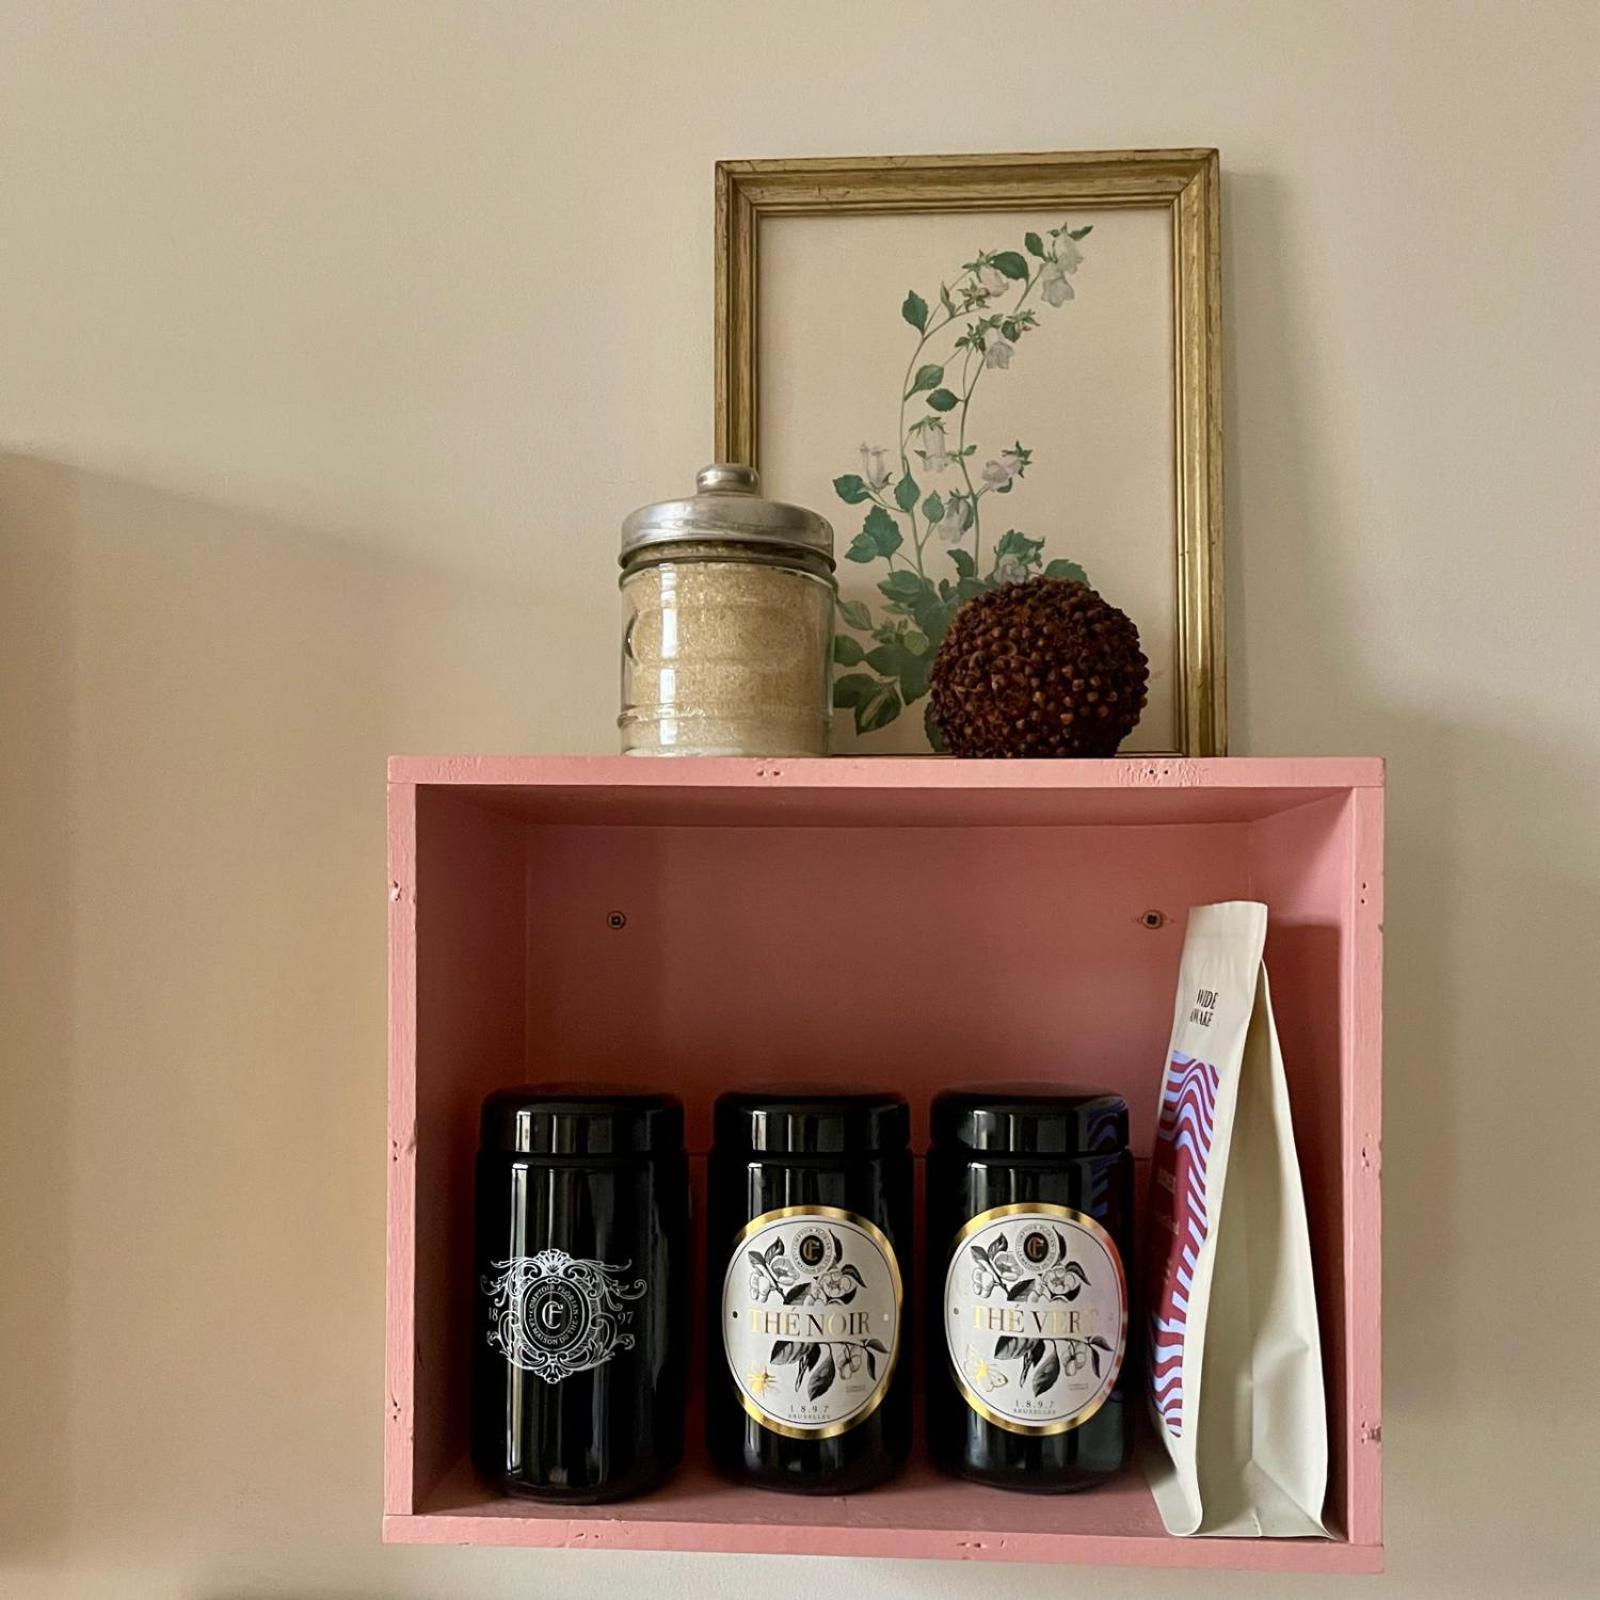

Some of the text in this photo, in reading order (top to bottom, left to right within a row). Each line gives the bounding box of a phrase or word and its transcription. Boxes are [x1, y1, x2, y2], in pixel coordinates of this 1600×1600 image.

[1196, 988, 1219, 1010] WIDE
[488, 1306, 499, 1322] 18
[616, 1311, 635, 1326] 97
[750, 1307, 871, 1337] THÉ NOIR
[974, 1304, 1025, 1334] THÉ
